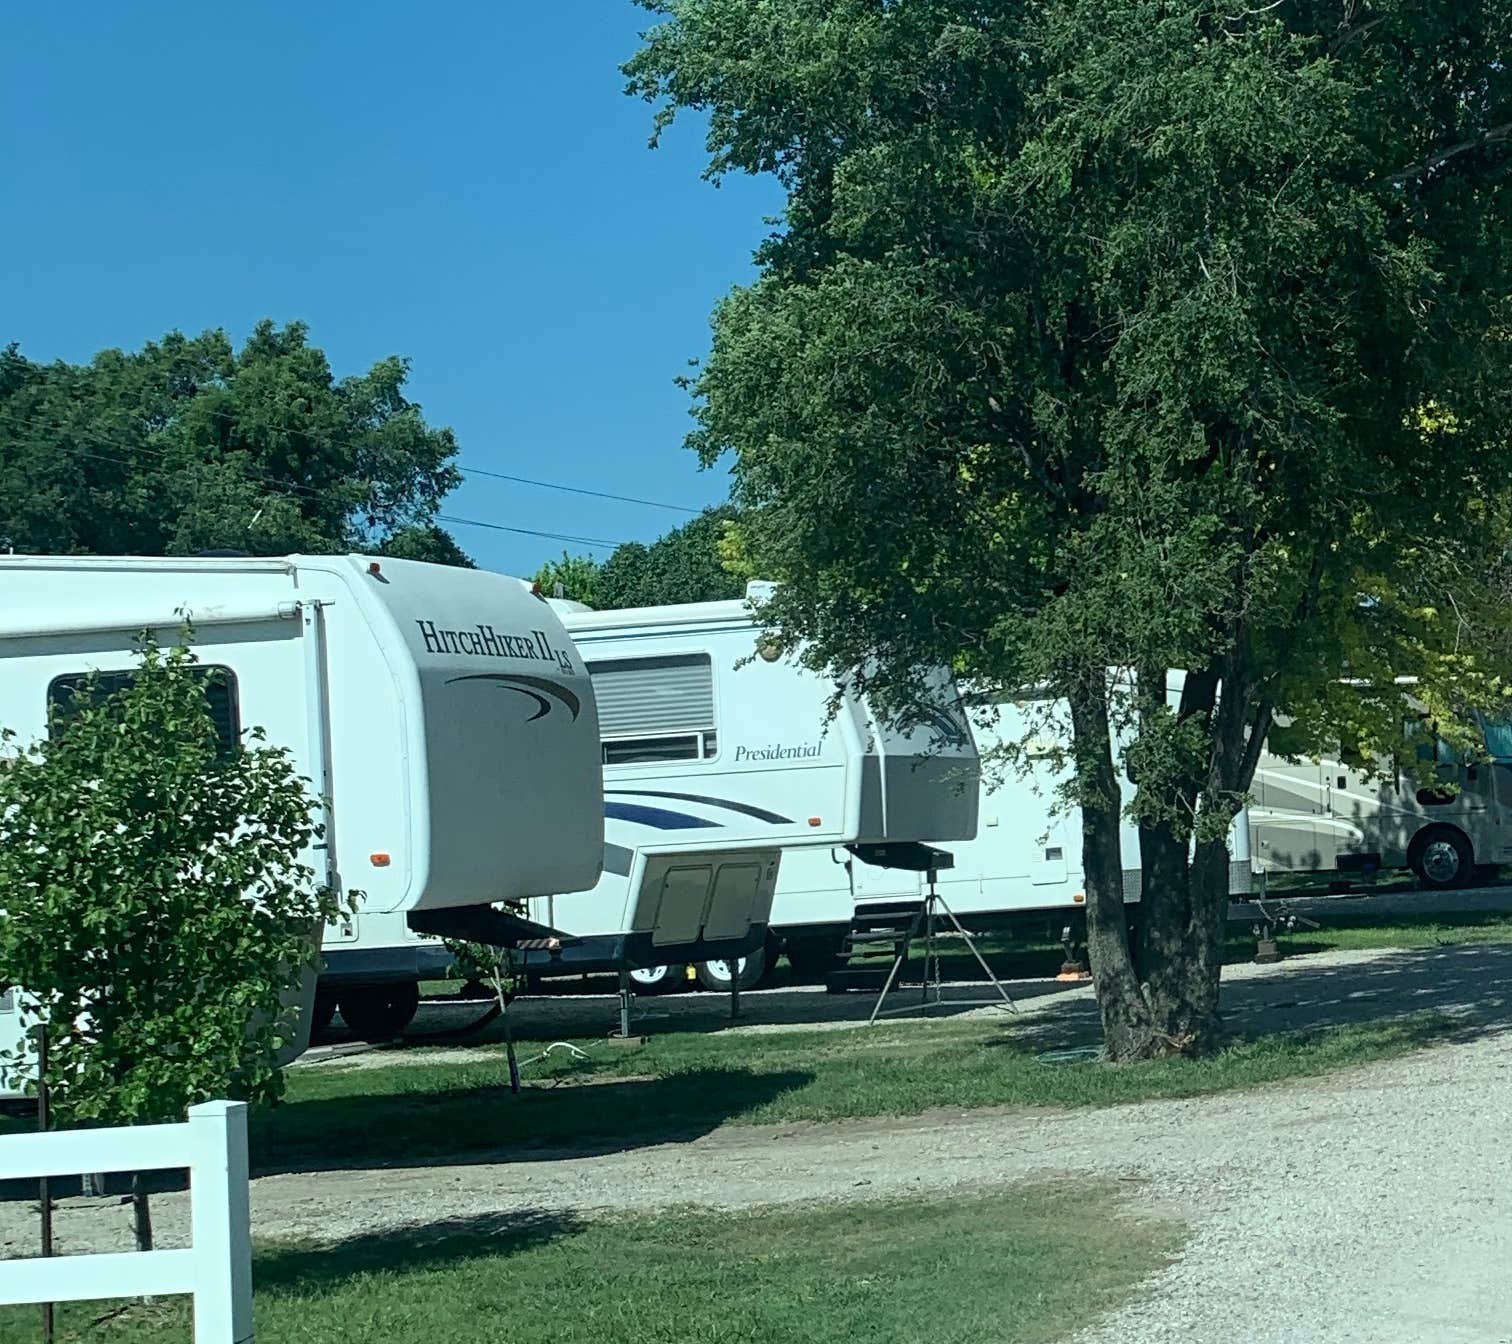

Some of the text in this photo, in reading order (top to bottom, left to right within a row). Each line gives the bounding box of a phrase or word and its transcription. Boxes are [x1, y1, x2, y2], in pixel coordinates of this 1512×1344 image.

[416, 620, 555, 661] HITCHHIKER II
[554, 649, 573, 669] LS
[734, 740, 822, 762] Presidential
